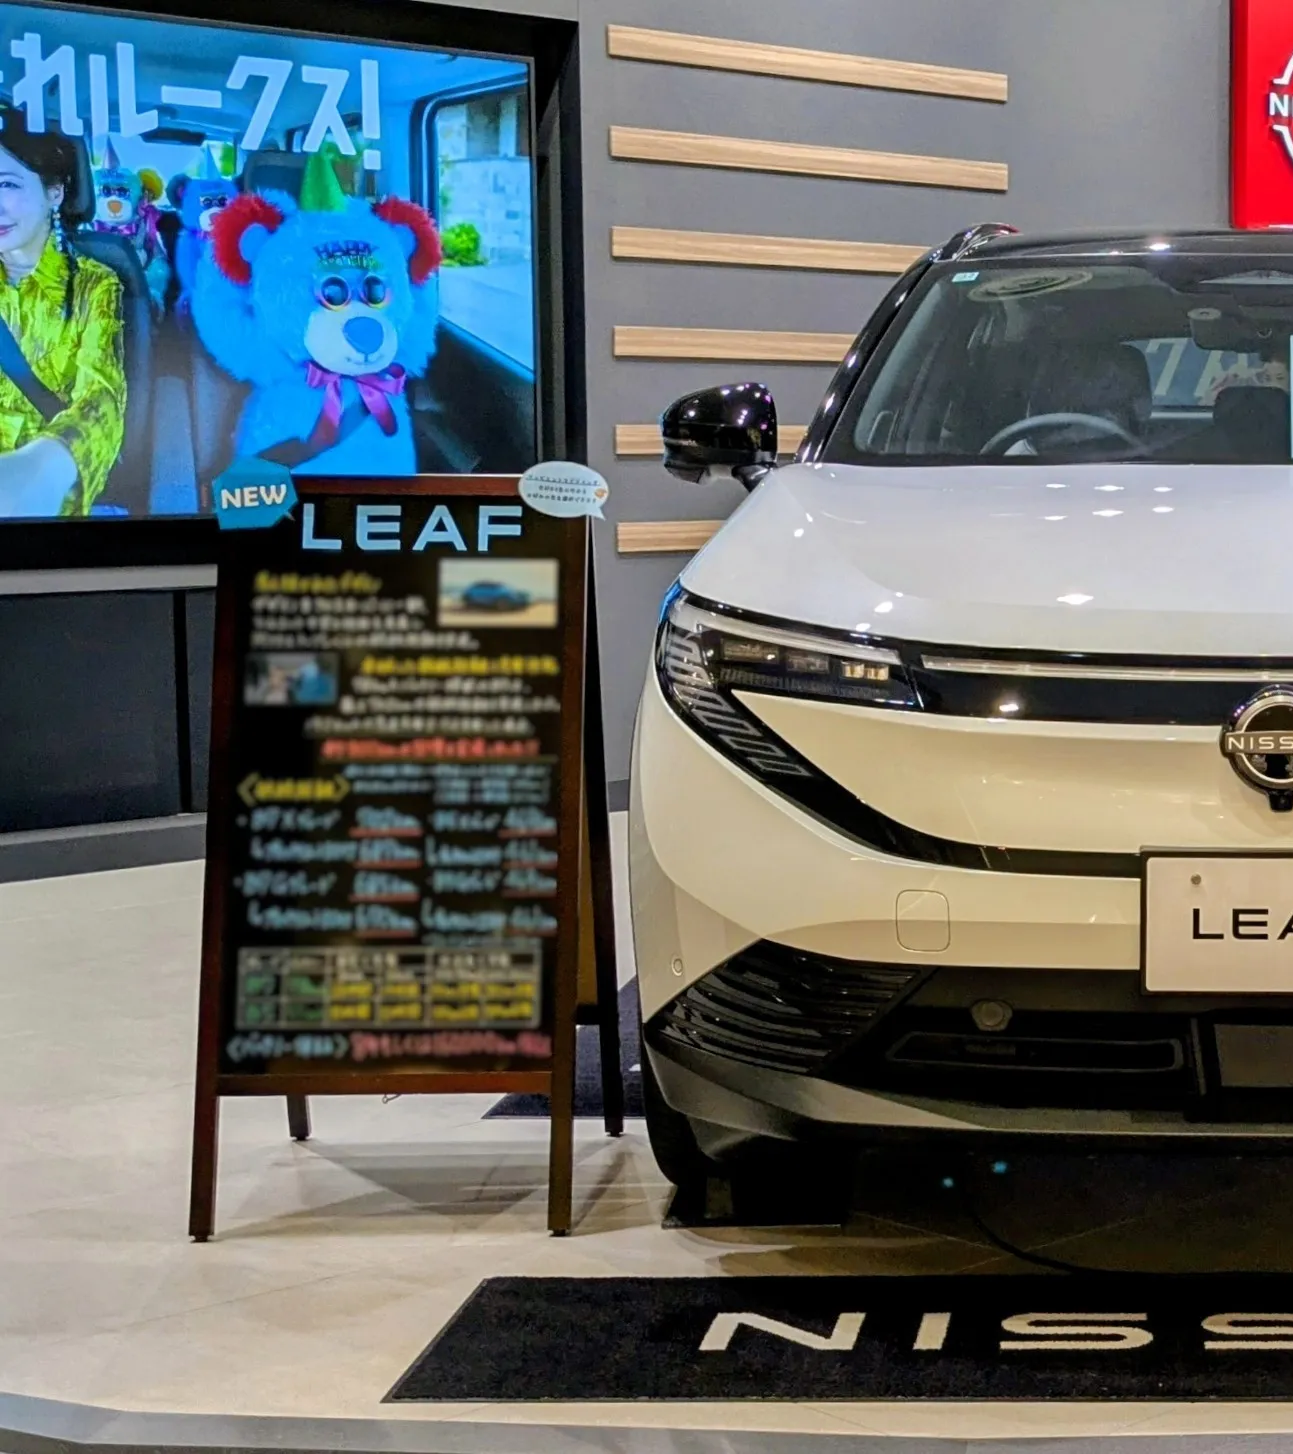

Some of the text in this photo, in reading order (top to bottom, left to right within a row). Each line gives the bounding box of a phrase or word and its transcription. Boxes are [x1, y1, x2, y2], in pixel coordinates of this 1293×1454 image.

[0, 32, 381, 170] れルークス!
[220, 484, 287, 509] NEW
[302, 503, 523, 551] LEAF
